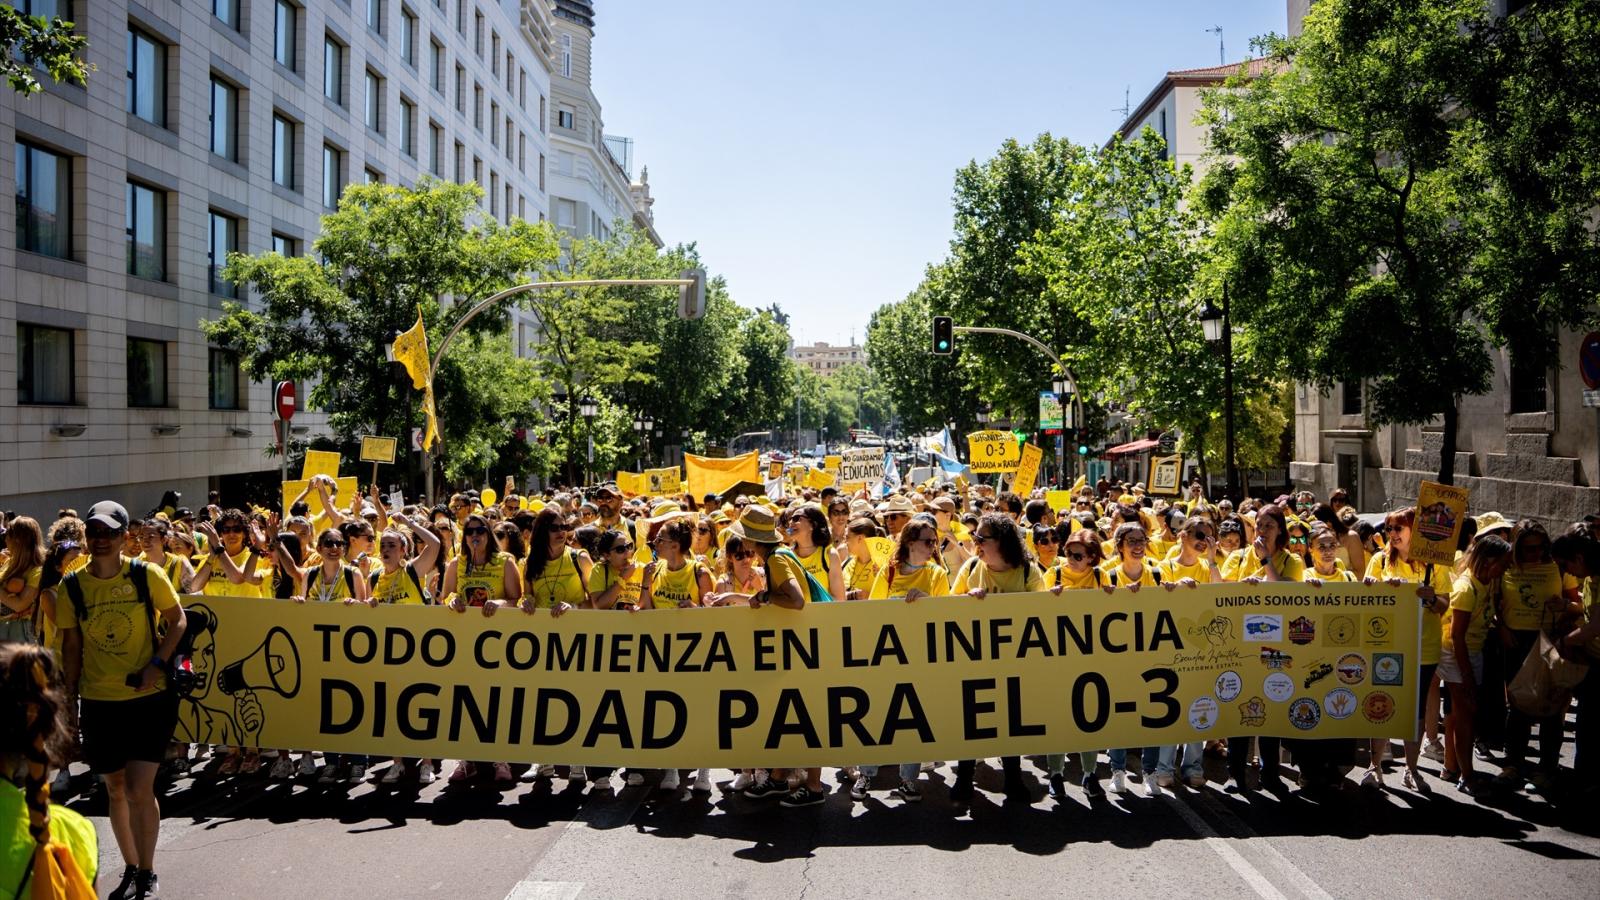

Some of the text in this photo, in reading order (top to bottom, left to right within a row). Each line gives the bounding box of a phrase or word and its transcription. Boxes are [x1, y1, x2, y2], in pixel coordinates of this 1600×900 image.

[986, 443, 1005, 456] 0-3
[842, 454, 884, 462] NO GUARDAMOS
[843, 463, 885, 480] EDUCAMOS
[1215, 593, 1396, 607] UNIDAS SOMOS MÁS FUERTES
[313, 609, 1185, 673] TODO COMIENZA EN LA INFANCIA
[318, 667, 1182, 750] DIGNIDAD PARA EL 0-3
